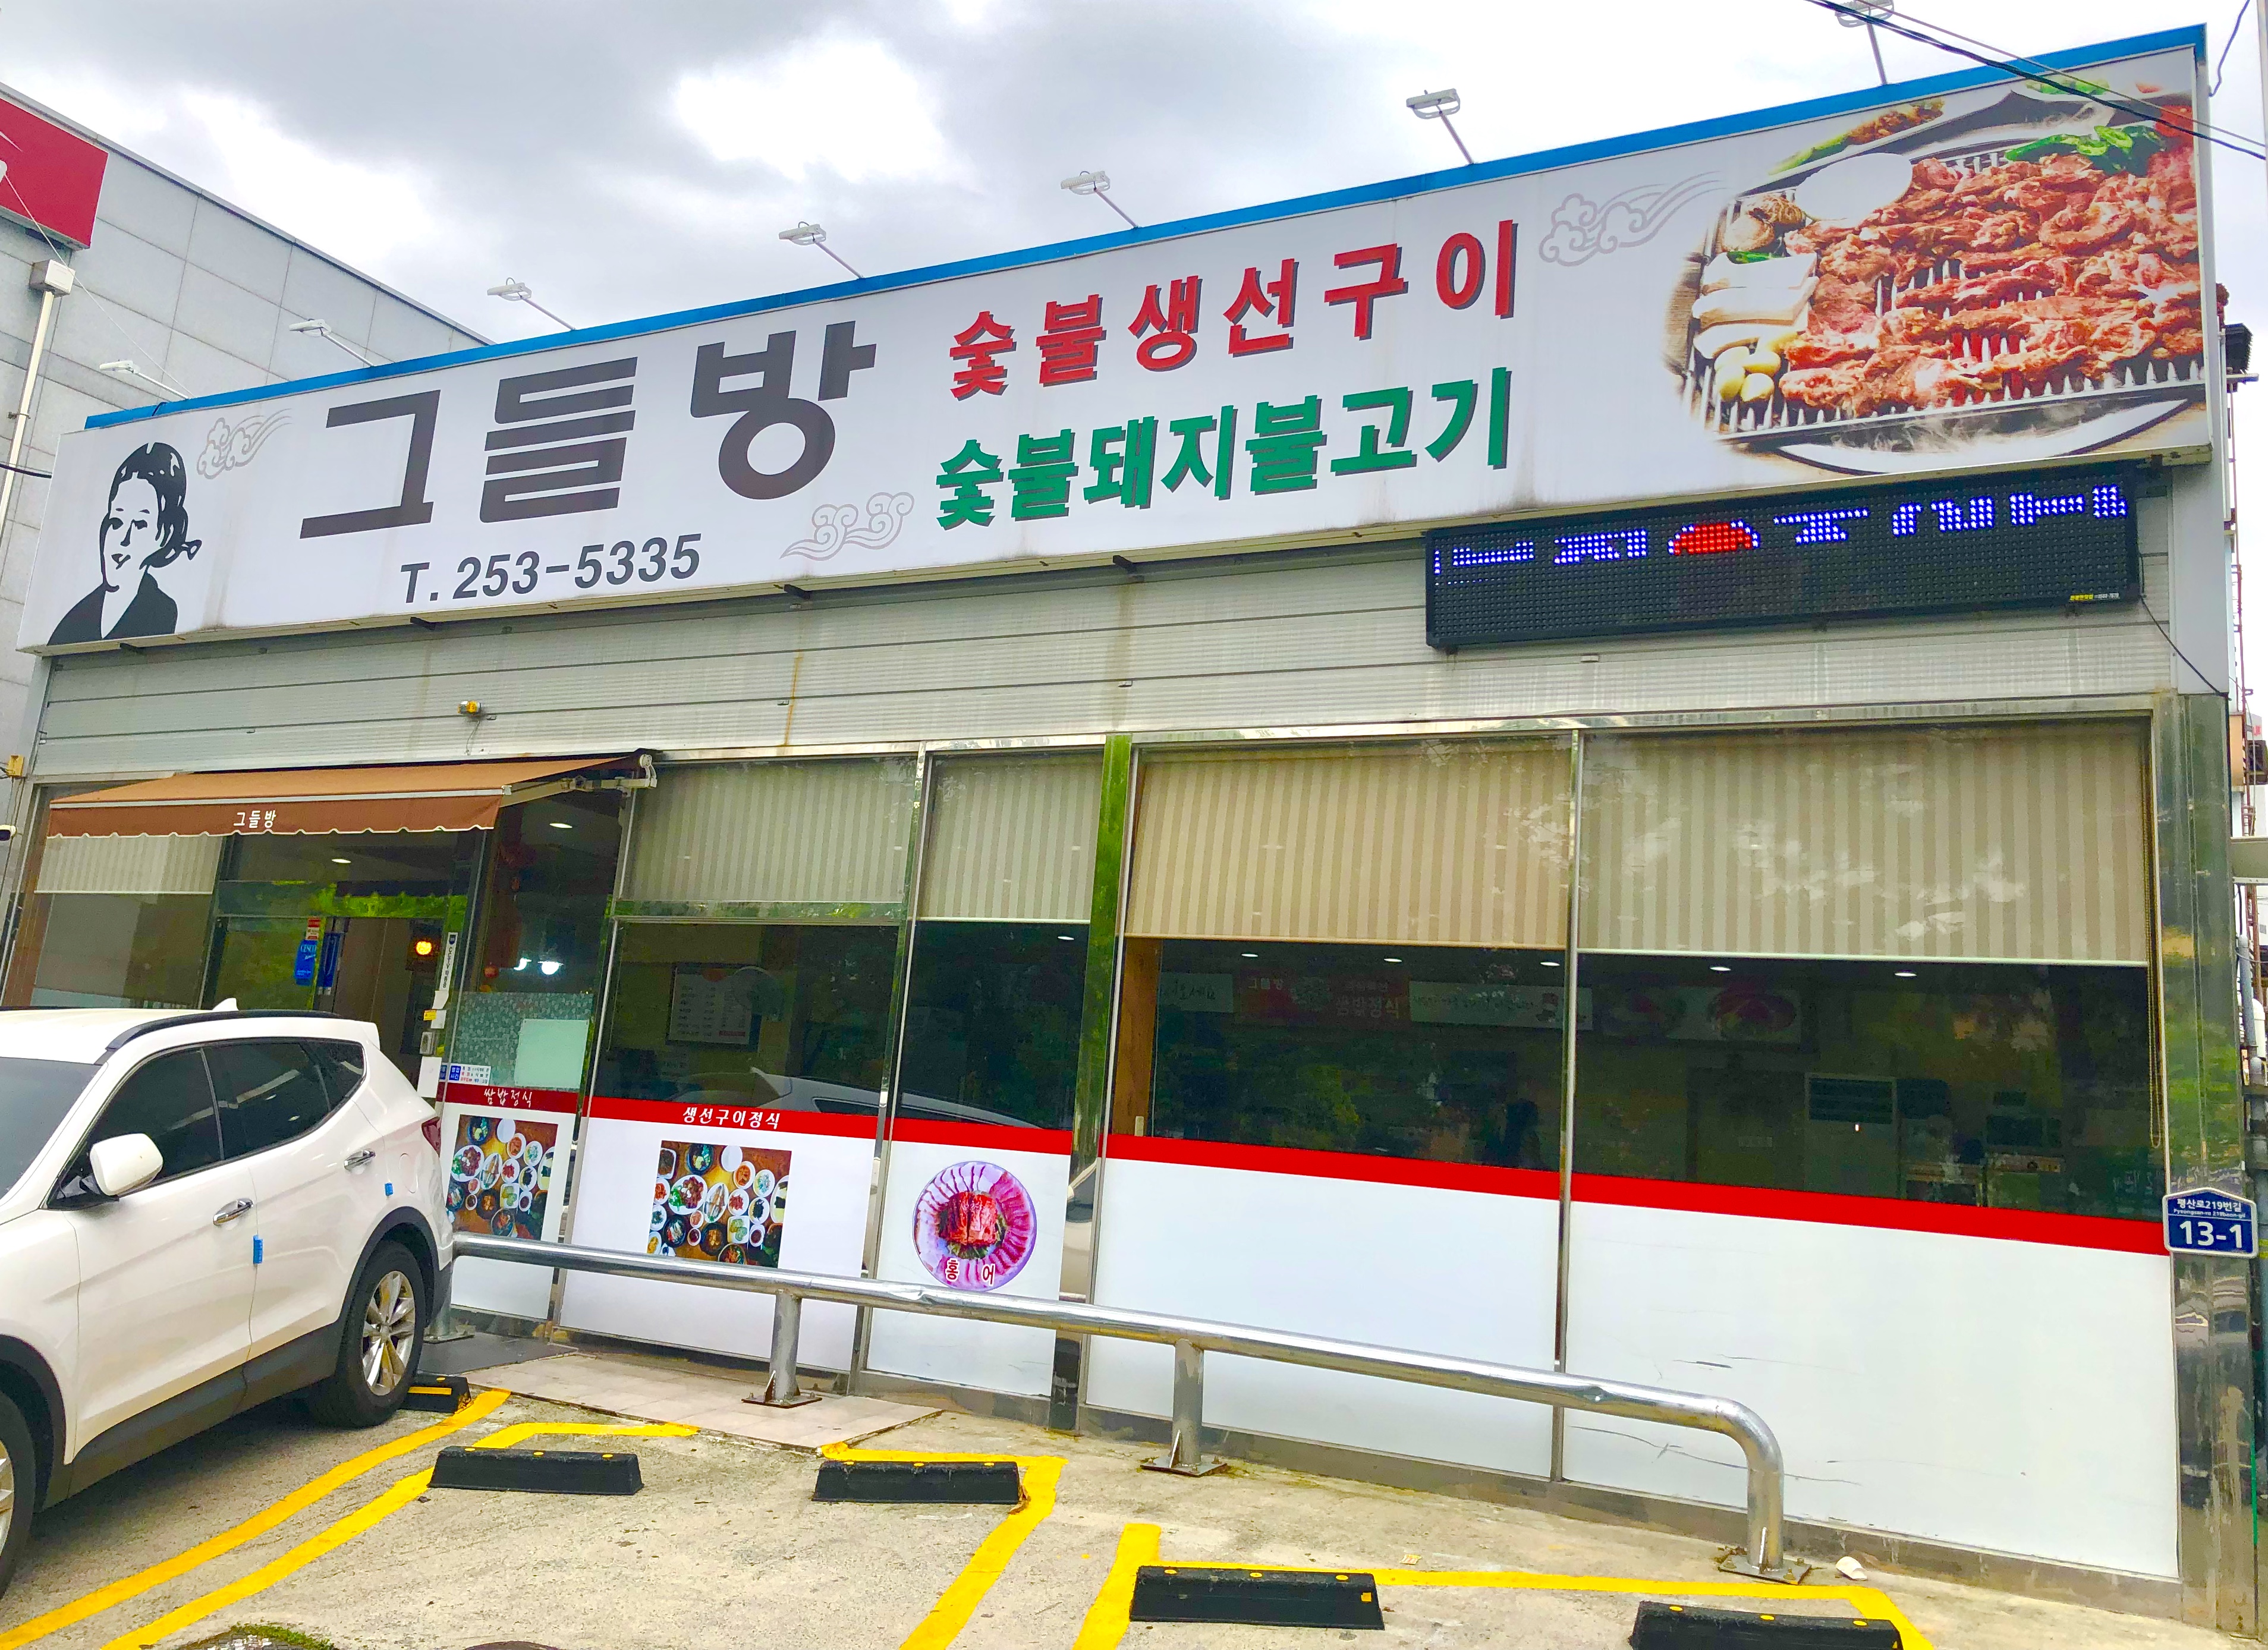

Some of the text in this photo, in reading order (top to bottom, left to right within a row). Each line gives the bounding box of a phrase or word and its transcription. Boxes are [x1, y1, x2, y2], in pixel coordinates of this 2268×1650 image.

[950, 220, 1518, 400] 숯불생선구이
[299, 321, 876, 539] 그들방
[936, 367, 1512, 530] 숯불돼지불고기
[401, 533, 702, 603] T. 253-5335
[233, 810, 276, 829] 그들방
[484, 1088, 533, 1108] 쌈밥정식
[682, 1107, 781, 1130] 생선구이정식
[2177, 1198, 2242, 1212] 평산로219번길
[2179, 1220, 2242, 1248] 13-1
[945, 1258, 995, 1286] 홍어
